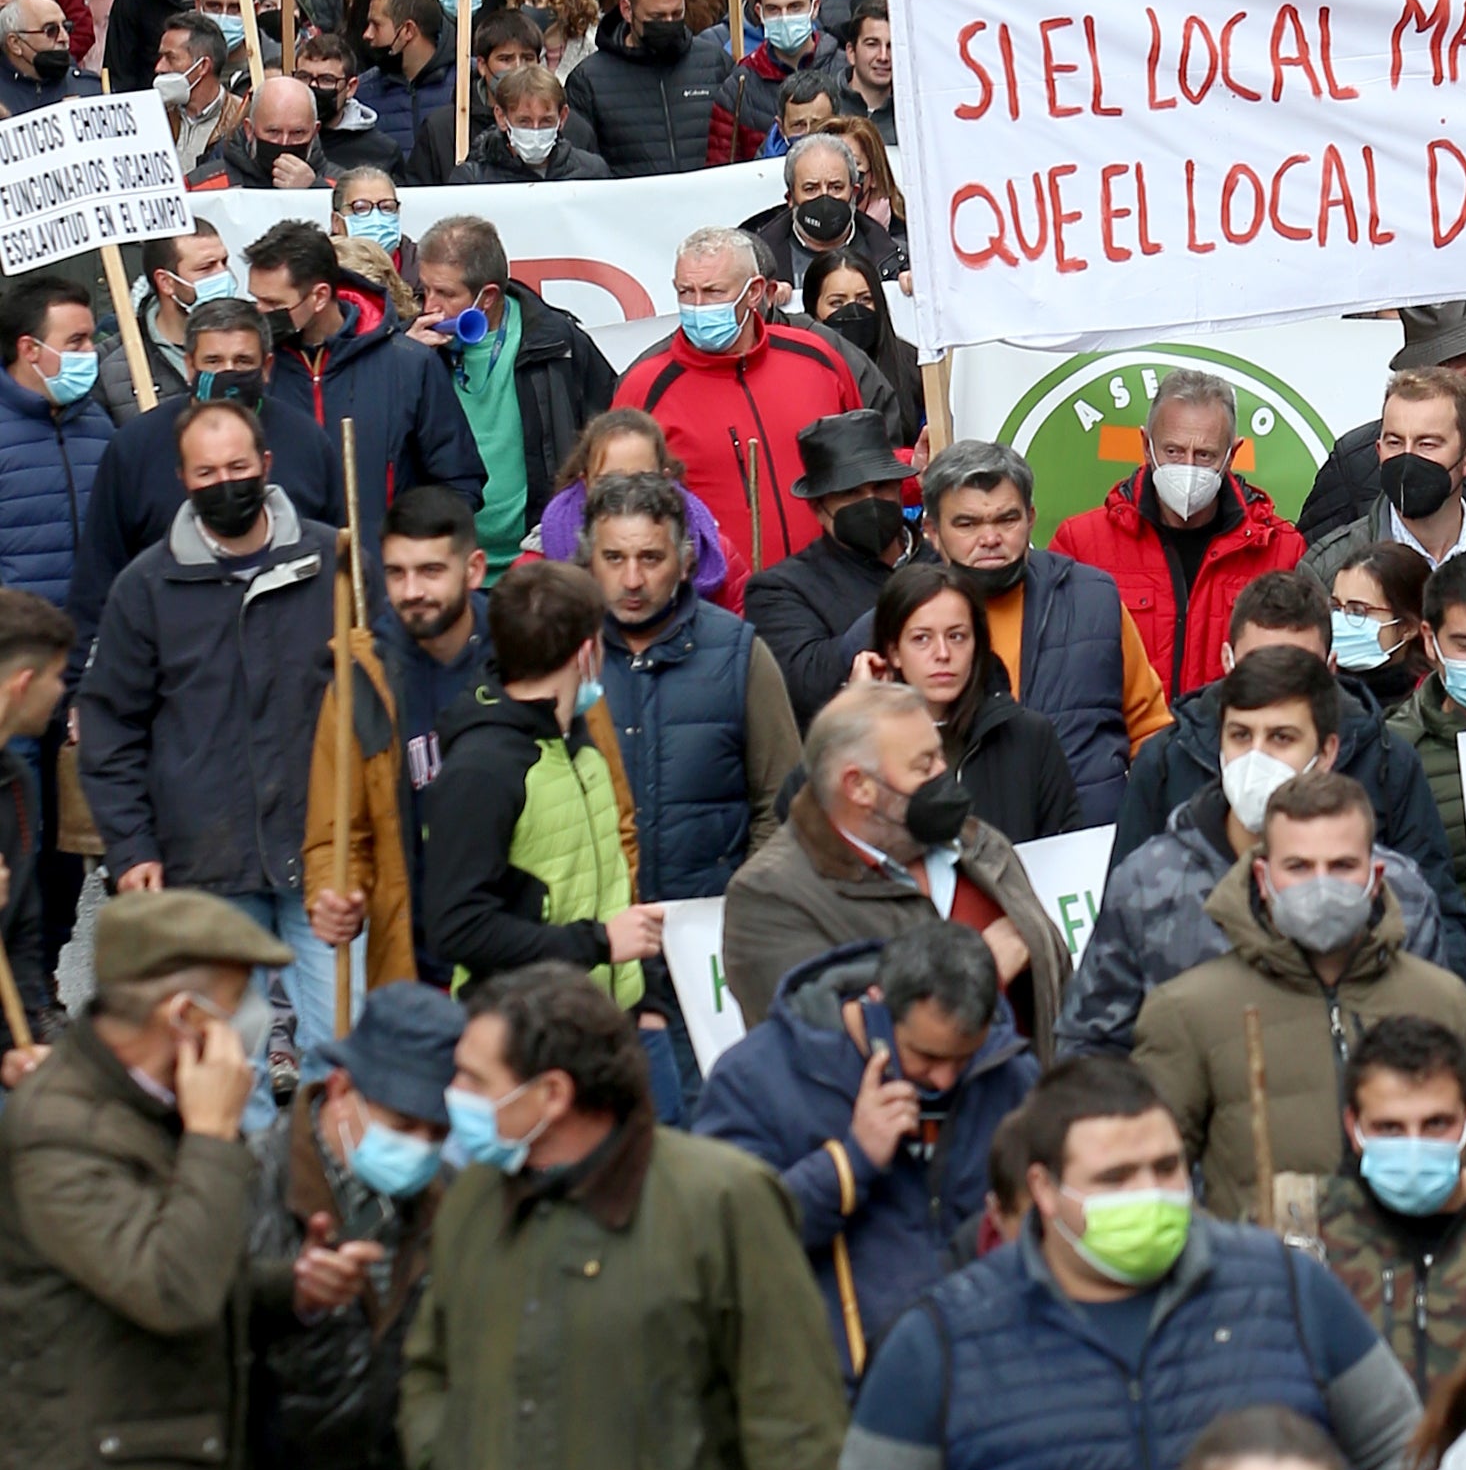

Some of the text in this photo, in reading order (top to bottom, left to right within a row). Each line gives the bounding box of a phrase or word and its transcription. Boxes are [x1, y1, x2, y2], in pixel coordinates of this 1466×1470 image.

[1146, 4, 1359, 110] LOCAL
[0, 101, 138, 166] OLITICOS CHORIZOS
[0, 149, 175, 221] FUNCIONARIOS SICARIOS
[1185, 144, 1395, 256] LOCAL
[1, 195, 188, 267] ESCLAVITUD EN EL CAMPO
